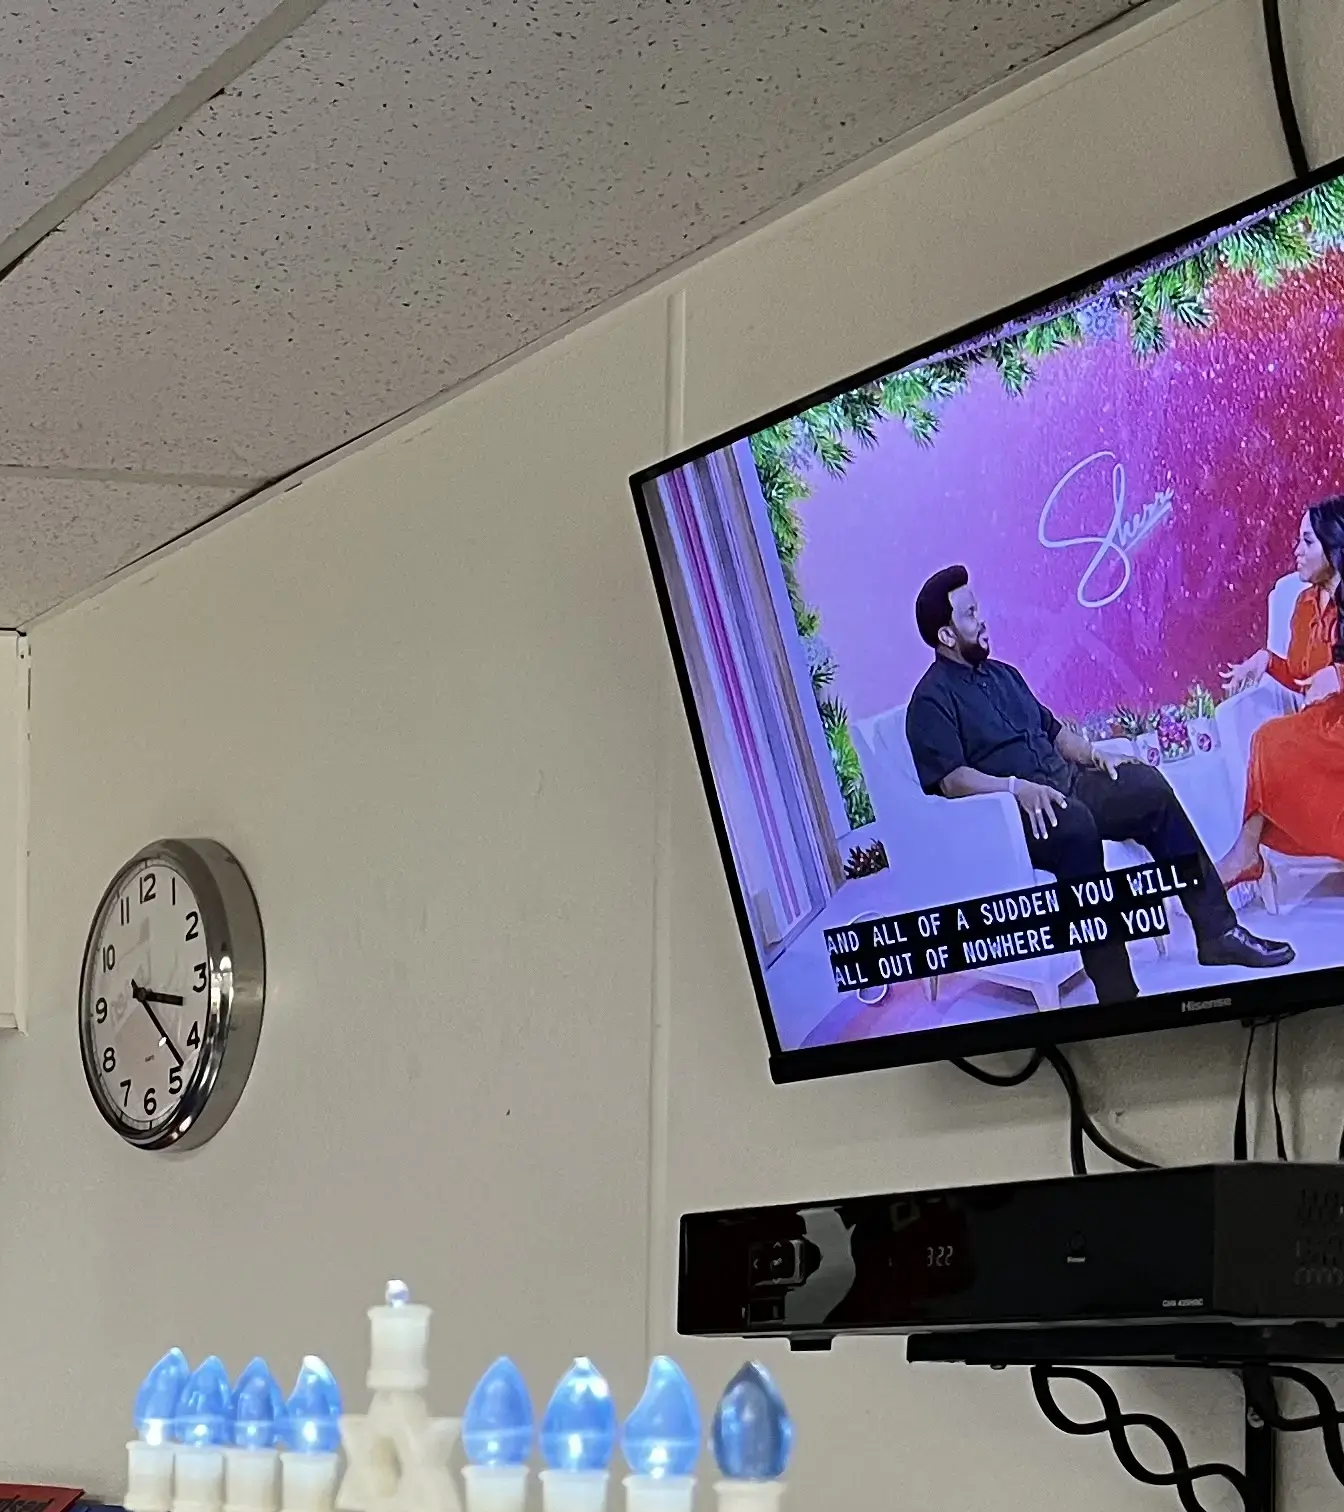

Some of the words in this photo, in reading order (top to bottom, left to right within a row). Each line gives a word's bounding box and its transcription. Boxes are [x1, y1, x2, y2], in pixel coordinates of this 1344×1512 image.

[139, 873, 156, 904] 12
[171, 877, 176, 905] 1
[120, 896, 130, 926] 11
[827, 930, 859, 954] AND
[873, 921, 907, 945] ALL
[918, 913, 941, 938] OF
[957, 908, 969, 930] A
[980, 889, 1060, 926] SUDDEN
[1070, 877, 1114, 907] YOU
[1126, 865, 1200, 897] WILL.
[185, 911, 199, 941] 2
[102, 944, 115, 973] 10
[833, 961, 868, 987] ALL
[879, 952, 914, 980] OUT
[926, 945, 949, 971] OF
[963, 928, 1054, 964] NOWHERE
[1069, 917, 1108, 945] AND
[1120, 905, 1166, 936] YOU
[192, 962, 207, 993] 3
[95, 997, 107, 1023] 9
[186, 1021, 200, 1049] 4
[102, 1047, 116, 1072] 8
[120, 1079, 132, 1107] 7
[169, 1067, 183, 1095] 5
[144, 1088, 157, 1115] 6
